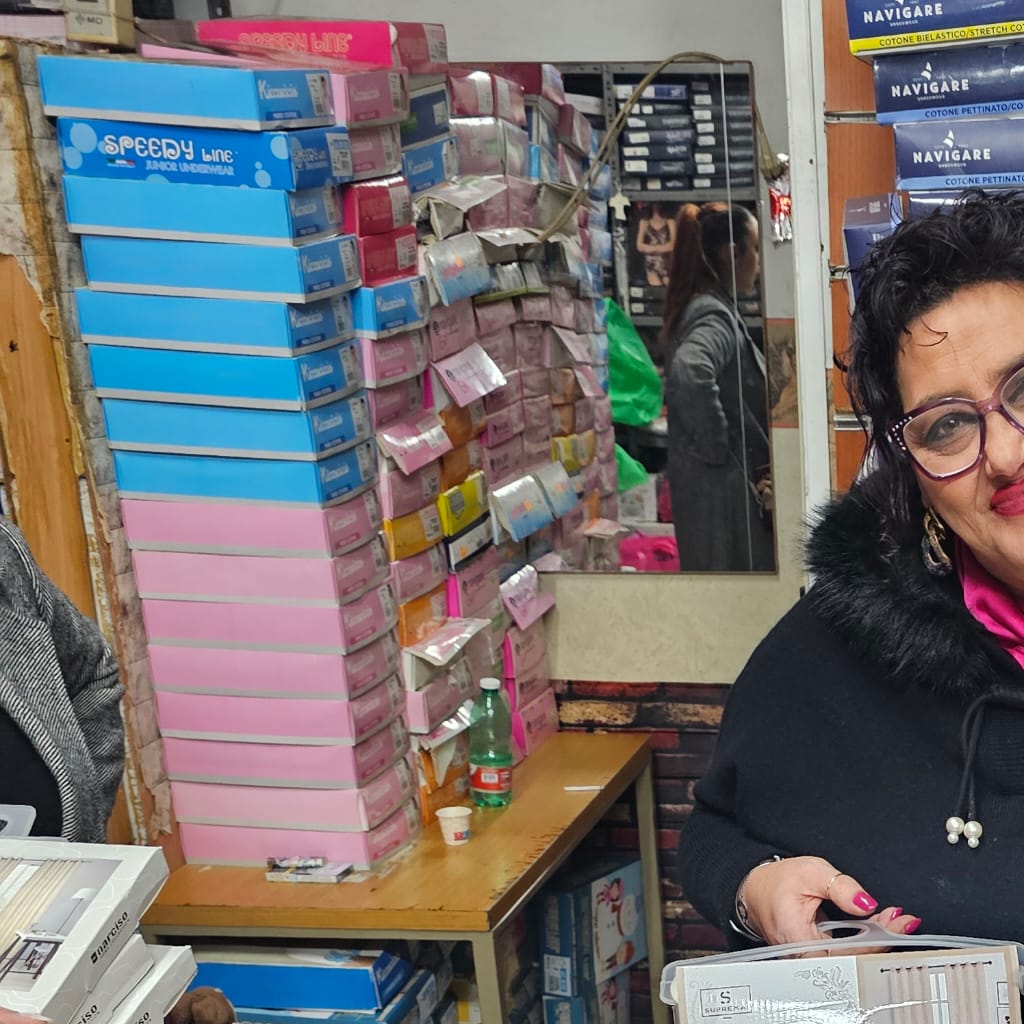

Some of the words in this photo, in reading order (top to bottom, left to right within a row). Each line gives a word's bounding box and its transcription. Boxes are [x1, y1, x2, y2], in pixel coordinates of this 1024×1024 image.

[864, 6, 942, 23] NAVIGARE
[880, 35, 914, 46] COTONE
[917, 25, 1008, 42] BIELASTICO/STRETCH
[892, 80, 969, 97] NAVIGARE
[925, 108, 959, 118] COTONE
[104, 134, 194, 160] SPEEDY
[913, 149, 991, 163] NAVIGARE
[146, 160, 178, 172] JUNIOR
[179, 161, 234, 176] UNDERWEAR
[97, 911, 129, 956] narciso
